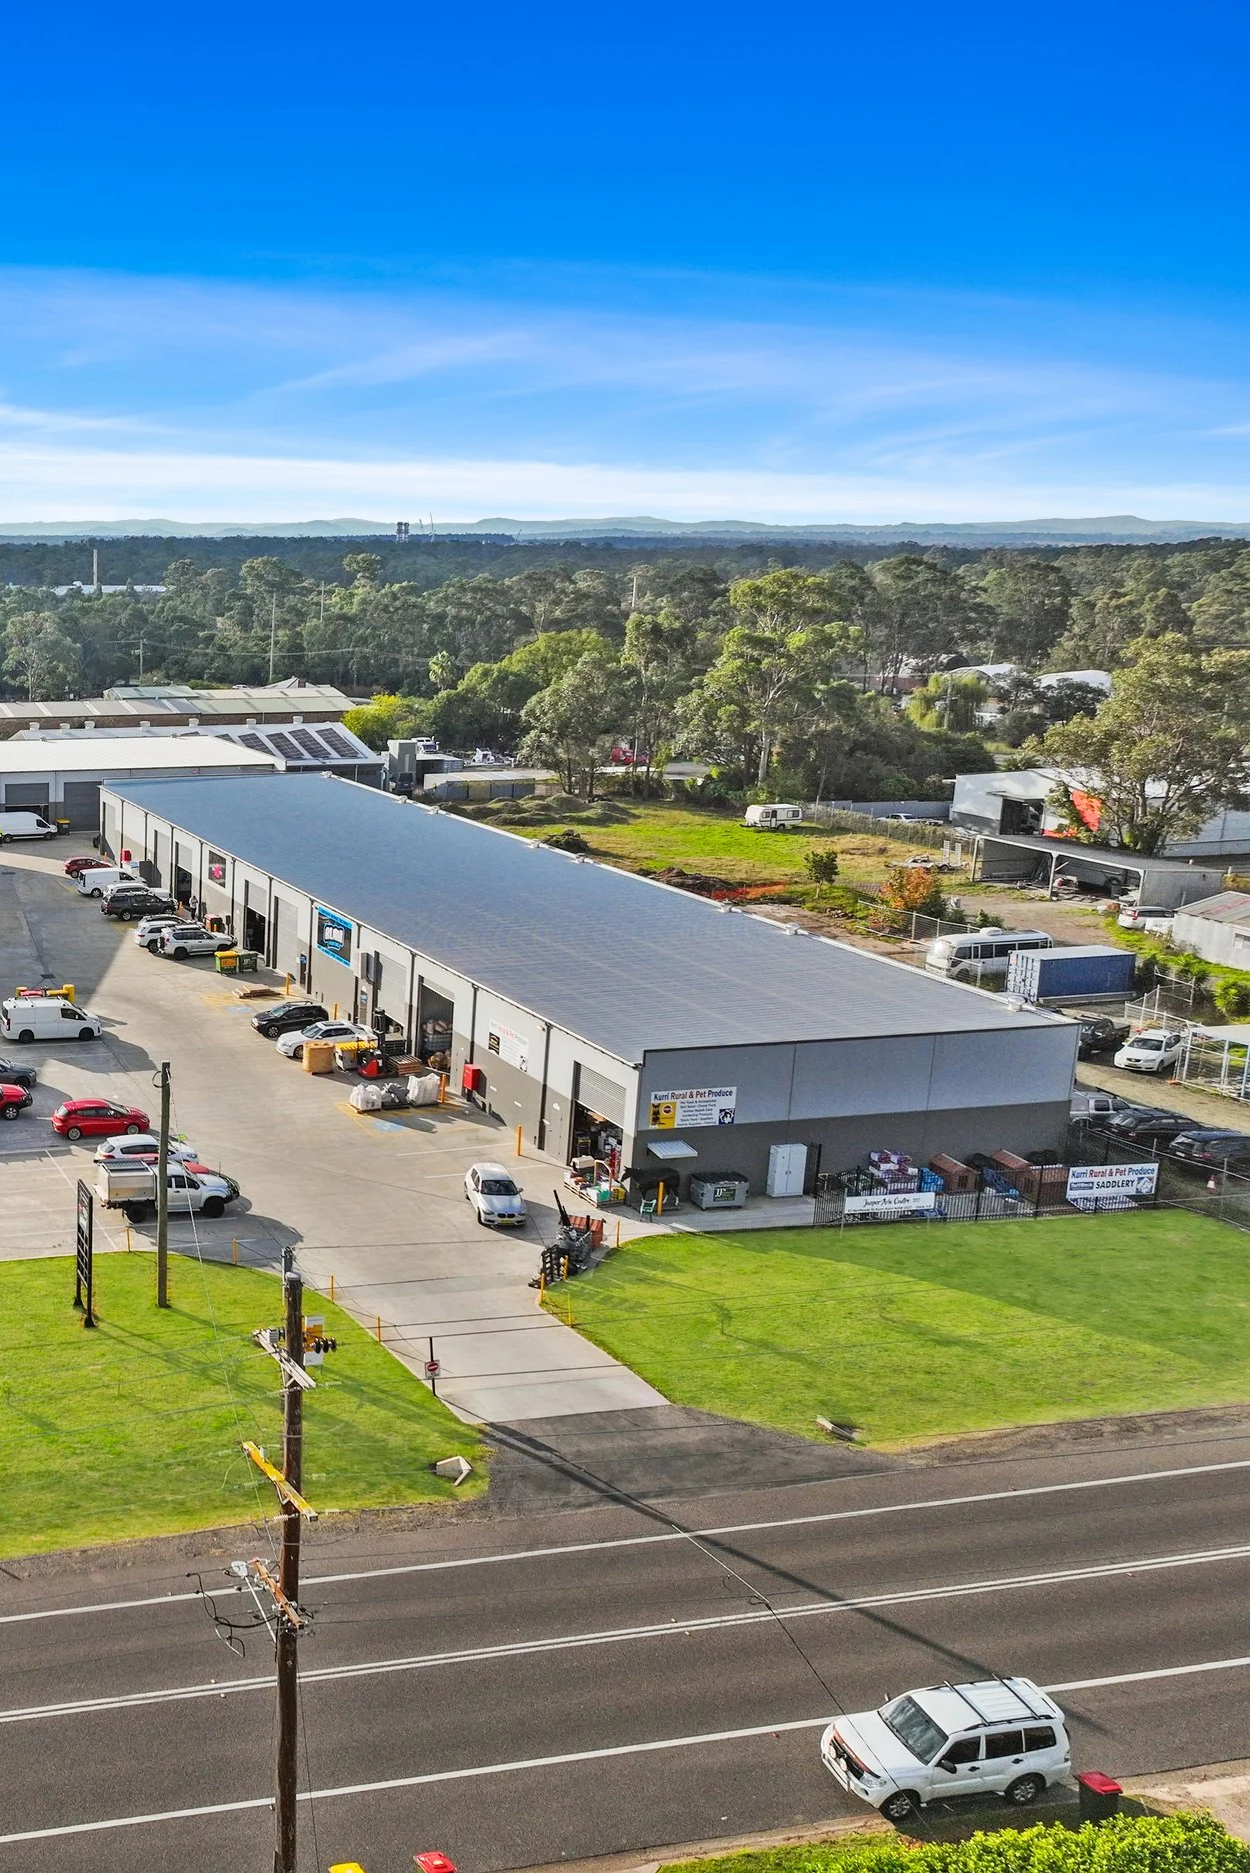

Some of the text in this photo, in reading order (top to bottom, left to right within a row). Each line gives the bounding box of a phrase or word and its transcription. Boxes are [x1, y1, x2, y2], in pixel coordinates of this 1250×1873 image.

[654, 1089, 733, 1101] Kurri Rural & Pet Produce
[1071, 1167, 1155, 1178] Kurri Rural & Pet Produce
[1095, 1179, 1135, 1189] SADDLERY
